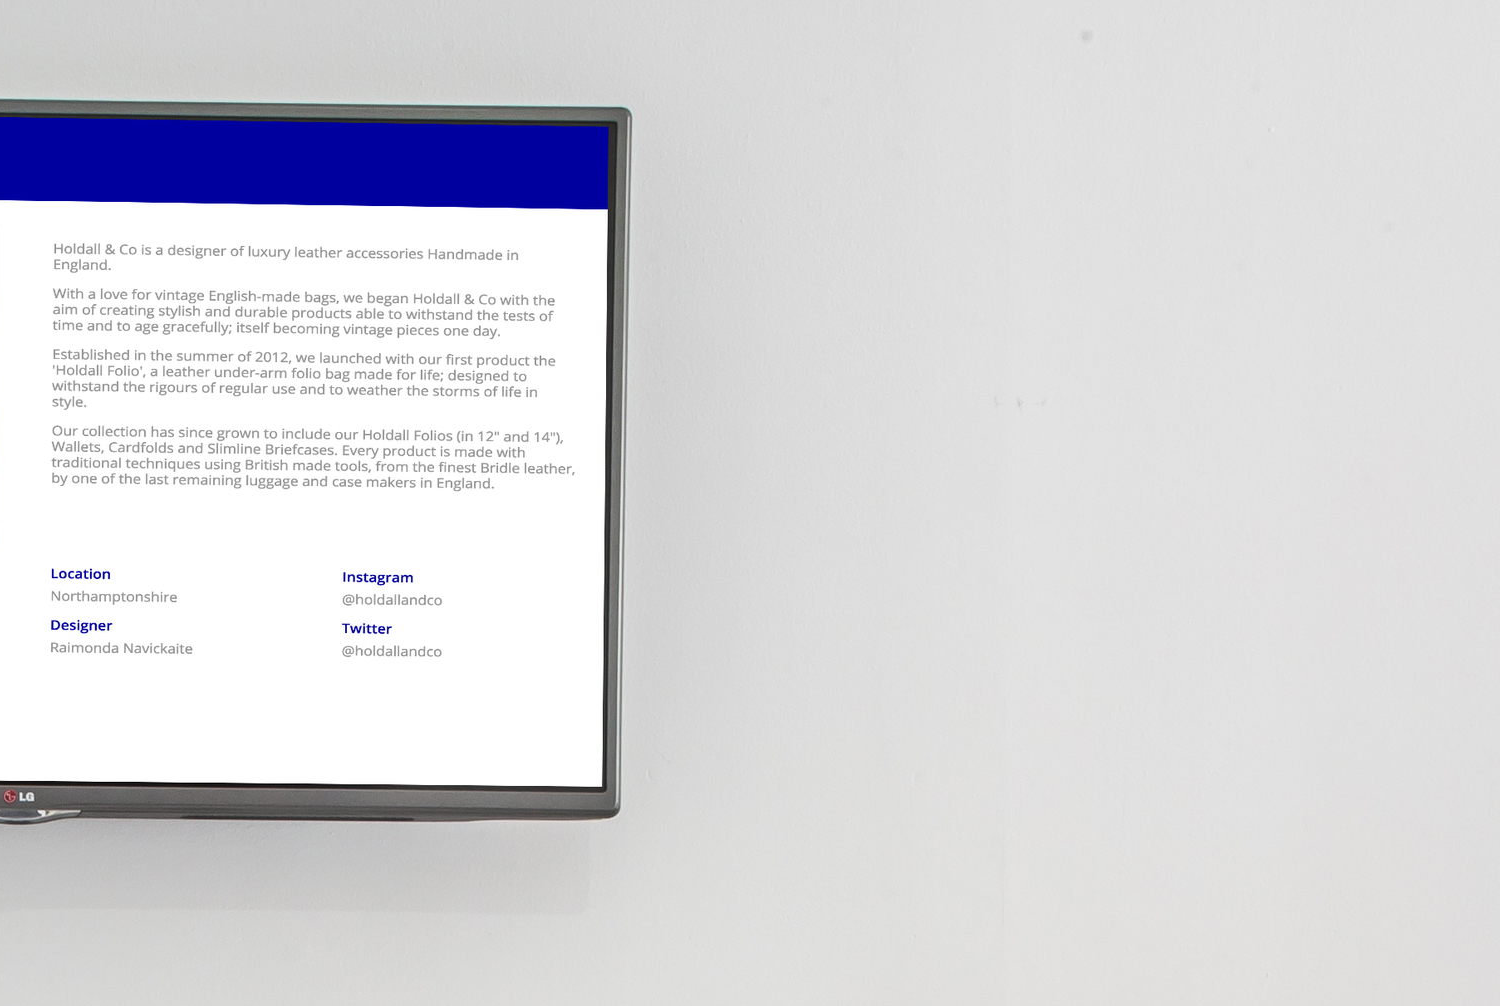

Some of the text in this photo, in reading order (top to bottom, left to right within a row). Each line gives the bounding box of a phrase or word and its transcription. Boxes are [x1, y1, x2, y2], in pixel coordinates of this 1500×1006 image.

[53, 242, 519, 261] Holdall & Co is a designer of luxury leather accessories Handmade in
[53, 258, 112, 274] England.
[52, 287, 556, 308] With a love for vintage English-made bags, we began Holdall & Co with the
[52, 303, 555, 322] aim of creating stylish and durable products able to withstand the tests of
[52, 319, 501, 340] time and to age gracefully; itself becoming vintage pieces one day.
[52, 348, 556, 369] Established in the summer of 2012, we launched with our first product the
[52, 364, 528, 385] 'Holdall Folio', a leather under-arm folio bag made for life; designed to
[51, 395, 87, 411] style.
[51, 424, 564, 446] Our collection has since grown to include our Holdall Folios (in 12" and 14"),
[51, 440, 526, 460] Wallets, Cardfolds and Slimline Briefcases. Every product is made with
[50, 456, 576, 476] traditional techniques using British made tools, from the finest Bridle leather,
[50, 567, 111, 580] Location
[342, 571, 414, 587] Instagram
[51, 590, 178, 606] Northamptonshire
[342, 593, 443, 607] @holdallandco
[50, 619, 114, 635] Designer
[341, 622, 393, 635] Twitter
[50, 641, 193, 655] Raimonda Navickaite
[341, 644, 443, 658] @holdallandco
[18, 791, 35, 802] LG
